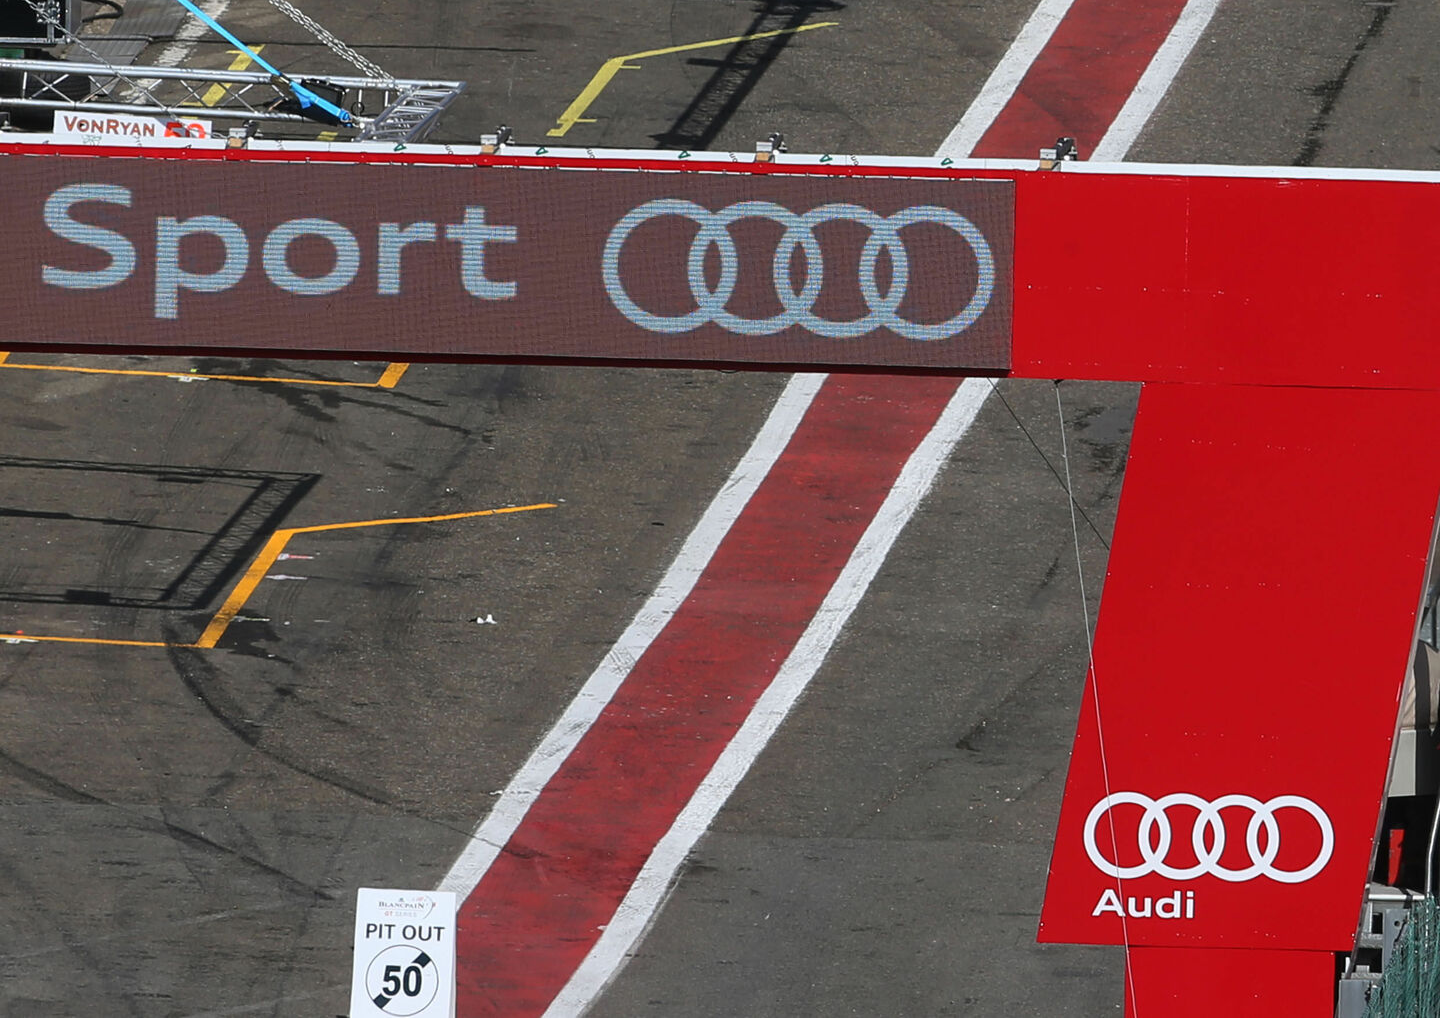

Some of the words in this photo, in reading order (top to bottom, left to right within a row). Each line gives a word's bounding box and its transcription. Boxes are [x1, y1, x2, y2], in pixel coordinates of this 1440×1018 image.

[42, 183, 518, 319] Sport
[378, 901, 425, 910] BLANCPAIN
[1092, 889, 1195, 919] Audi
[366, 923, 396, 939] PIT
[402, 925, 445, 941] OUT
[382, 965, 422, 997] 50
